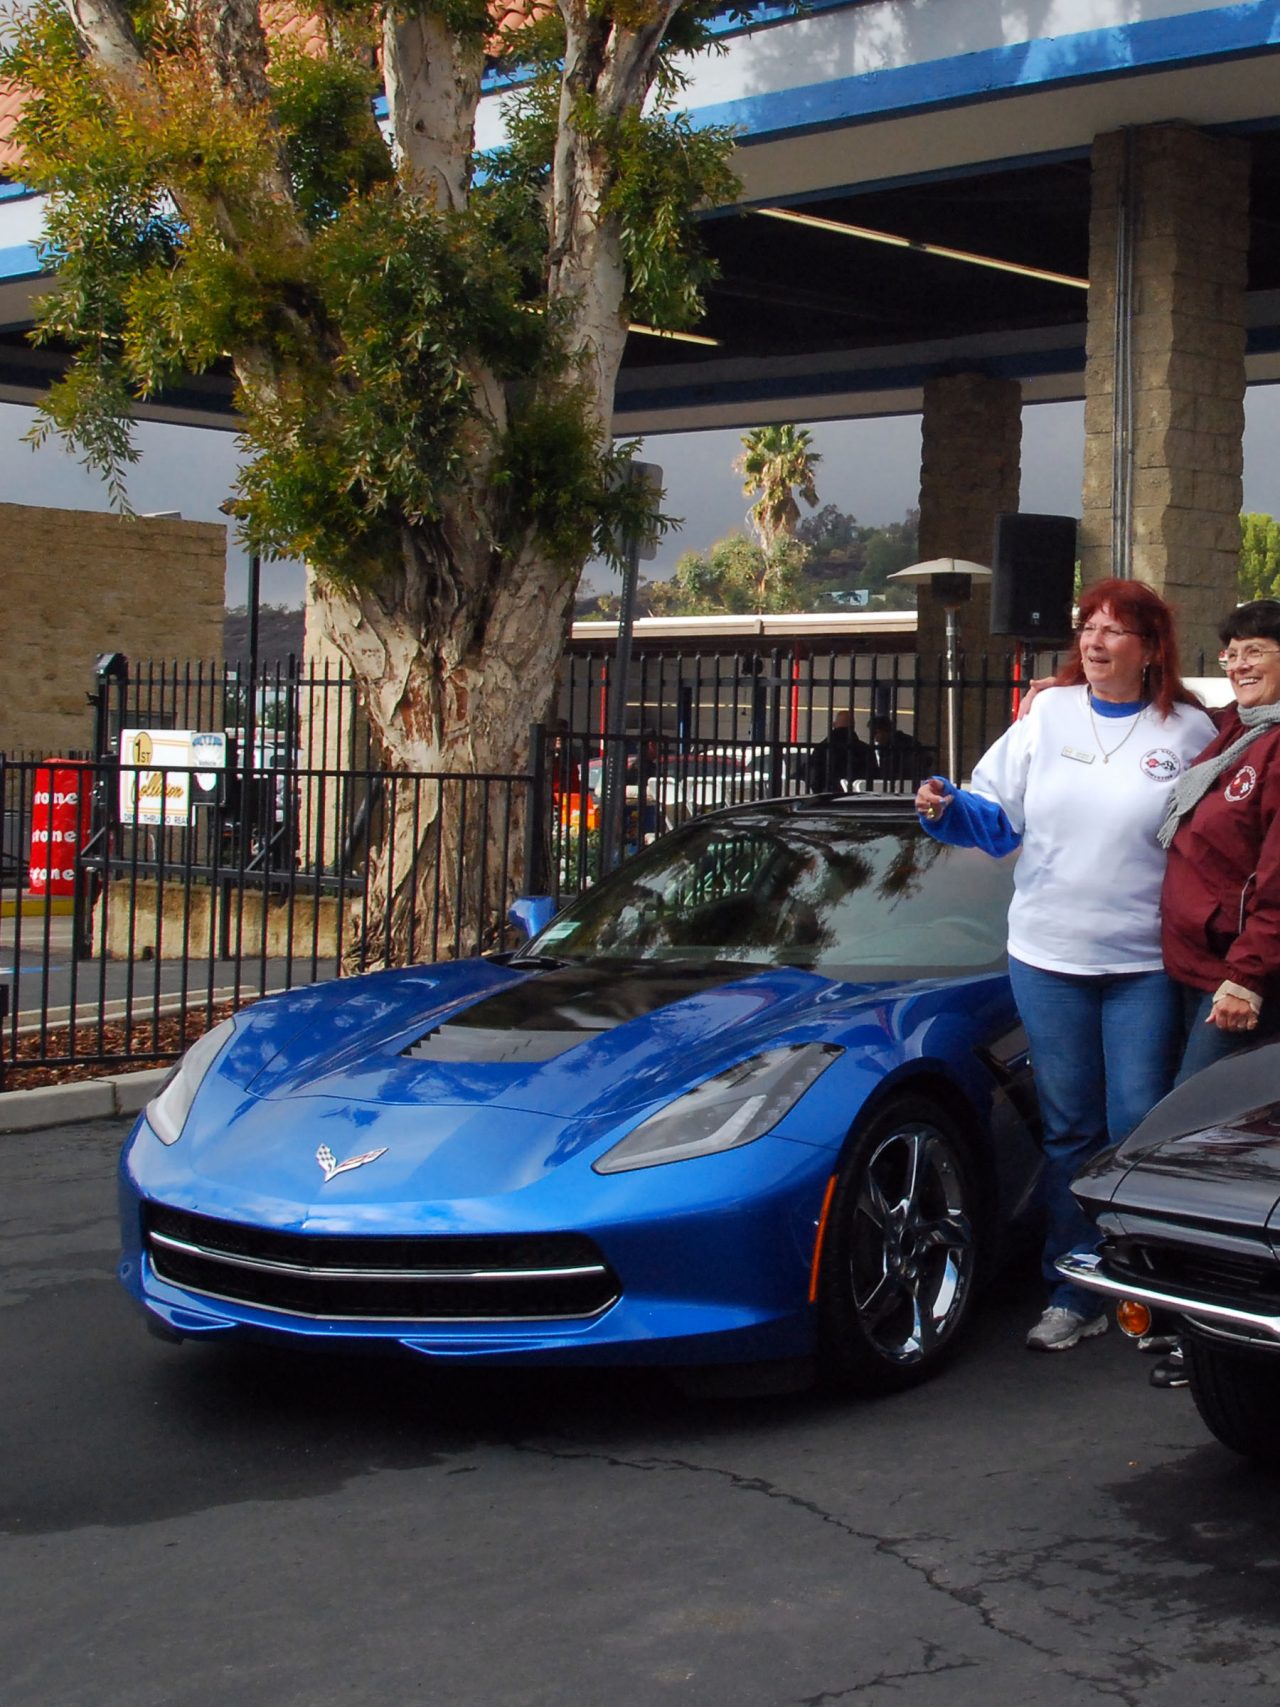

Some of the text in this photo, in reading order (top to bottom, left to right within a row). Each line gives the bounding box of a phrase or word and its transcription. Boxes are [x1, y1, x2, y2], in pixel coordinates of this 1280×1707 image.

[131, 771, 184, 804] olliion
[34, 791, 78, 805] tone
[32, 829, 77, 842] tone
